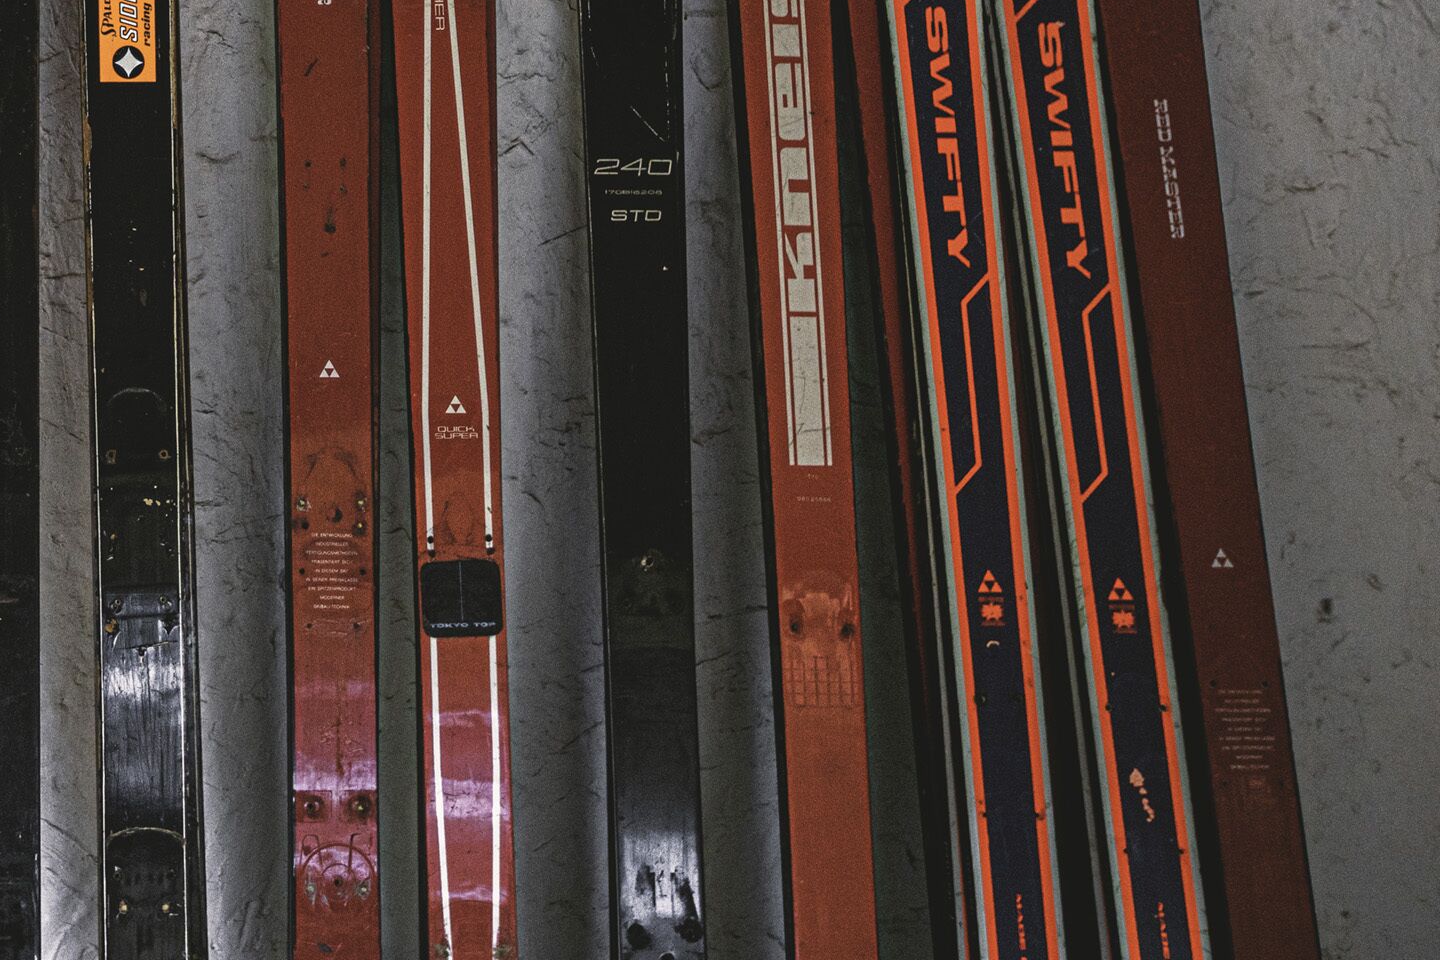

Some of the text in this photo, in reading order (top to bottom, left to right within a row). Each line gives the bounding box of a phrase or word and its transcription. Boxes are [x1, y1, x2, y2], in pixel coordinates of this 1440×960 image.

[141, 3, 152, 47] racing
[925, 6, 970, 268] SWIFTY
[1038, 22, 1091, 279] SWIFTY
[594, 157, 672, 177] 240
[1153, 98, 1184, 239] RED MASTER
[610, 209, 662, 223] STD
[434, 432, 479, 440] SUPER
[437, 425, 475, 433] QUICK
